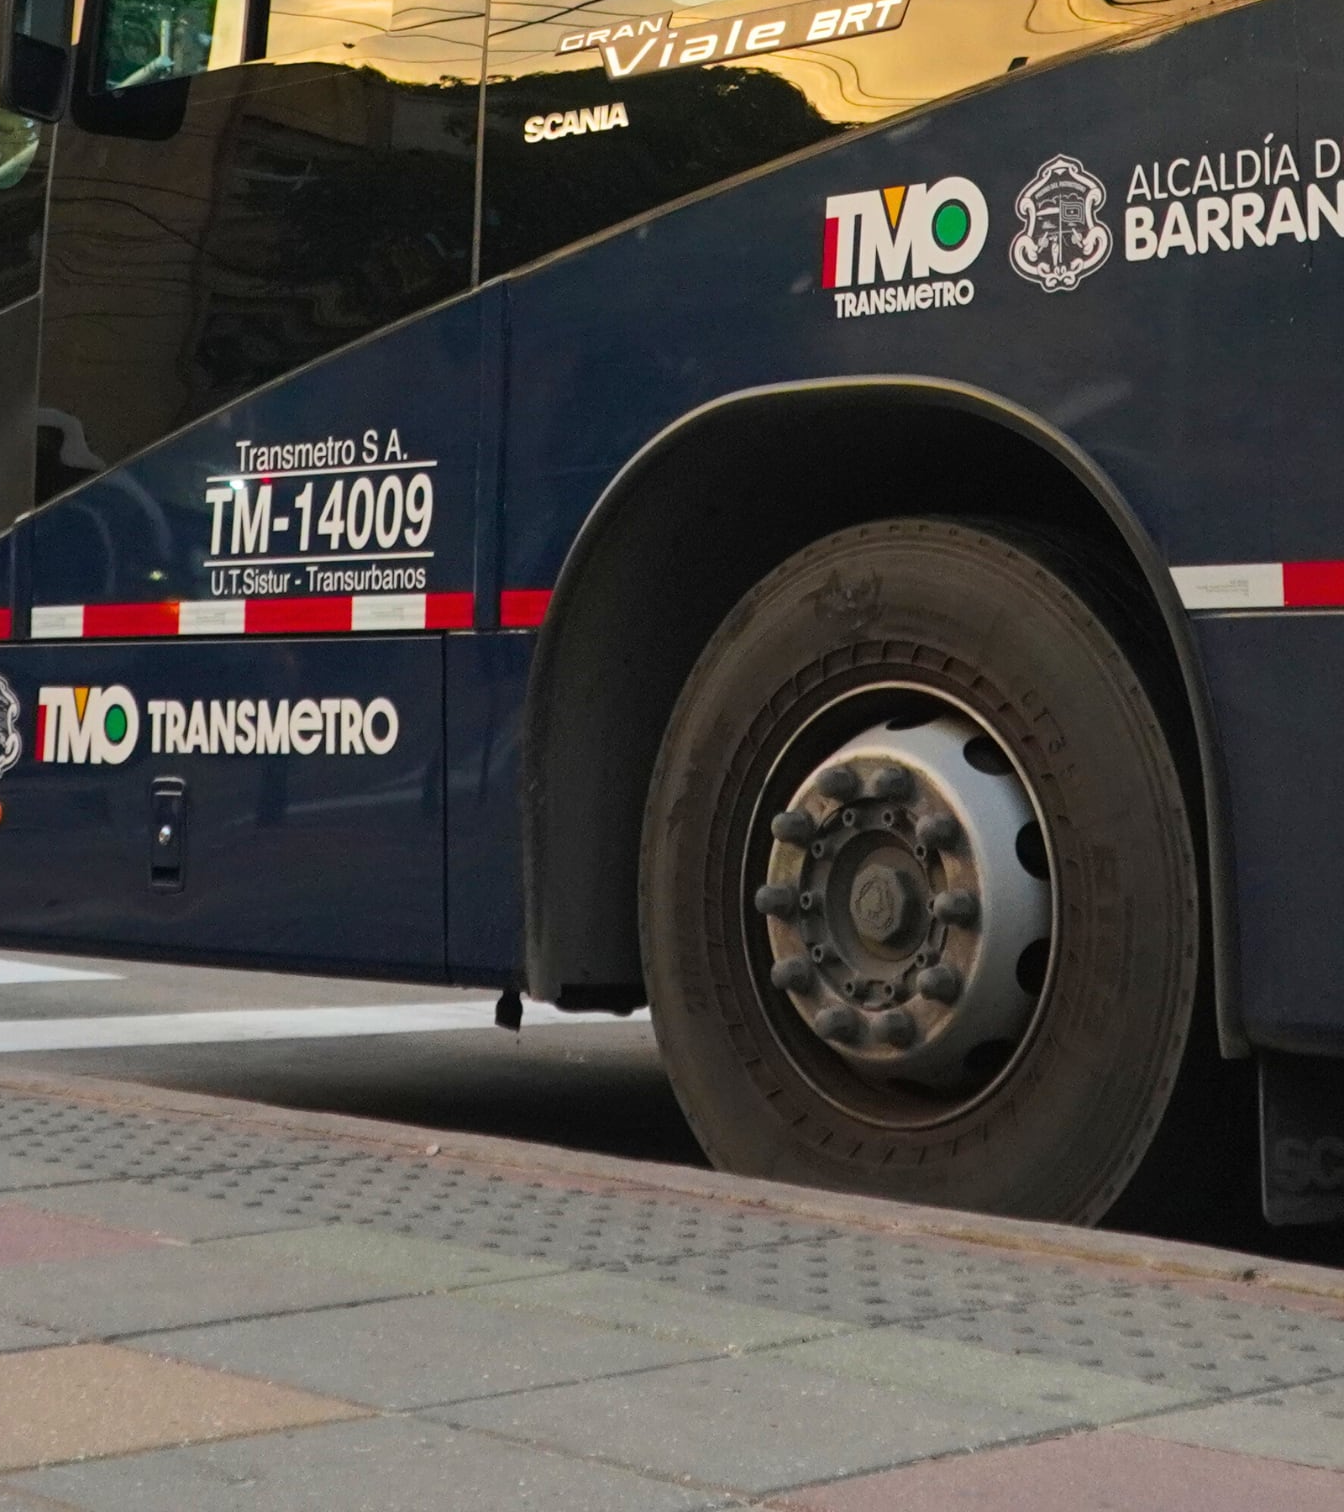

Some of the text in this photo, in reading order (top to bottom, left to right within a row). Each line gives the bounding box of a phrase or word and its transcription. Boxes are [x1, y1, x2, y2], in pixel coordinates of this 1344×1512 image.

[560, 16, 665, 52] GRAN
[605, 20, 787, 77] Viale
[523, 102, 630, 144] SCANIA
[1126, 133, 1300, 203] ALCALDÍA
[822, 176, 990, 289] TMO
[236, 436, 356, 472] Transmetro
[206, 473, 434, 556] TM-14009
[211, 569, 291, 596] U.T.Sistur
[306, 565, 426, 593] Transurbanos
[35, 685, 140, 765] TMO
